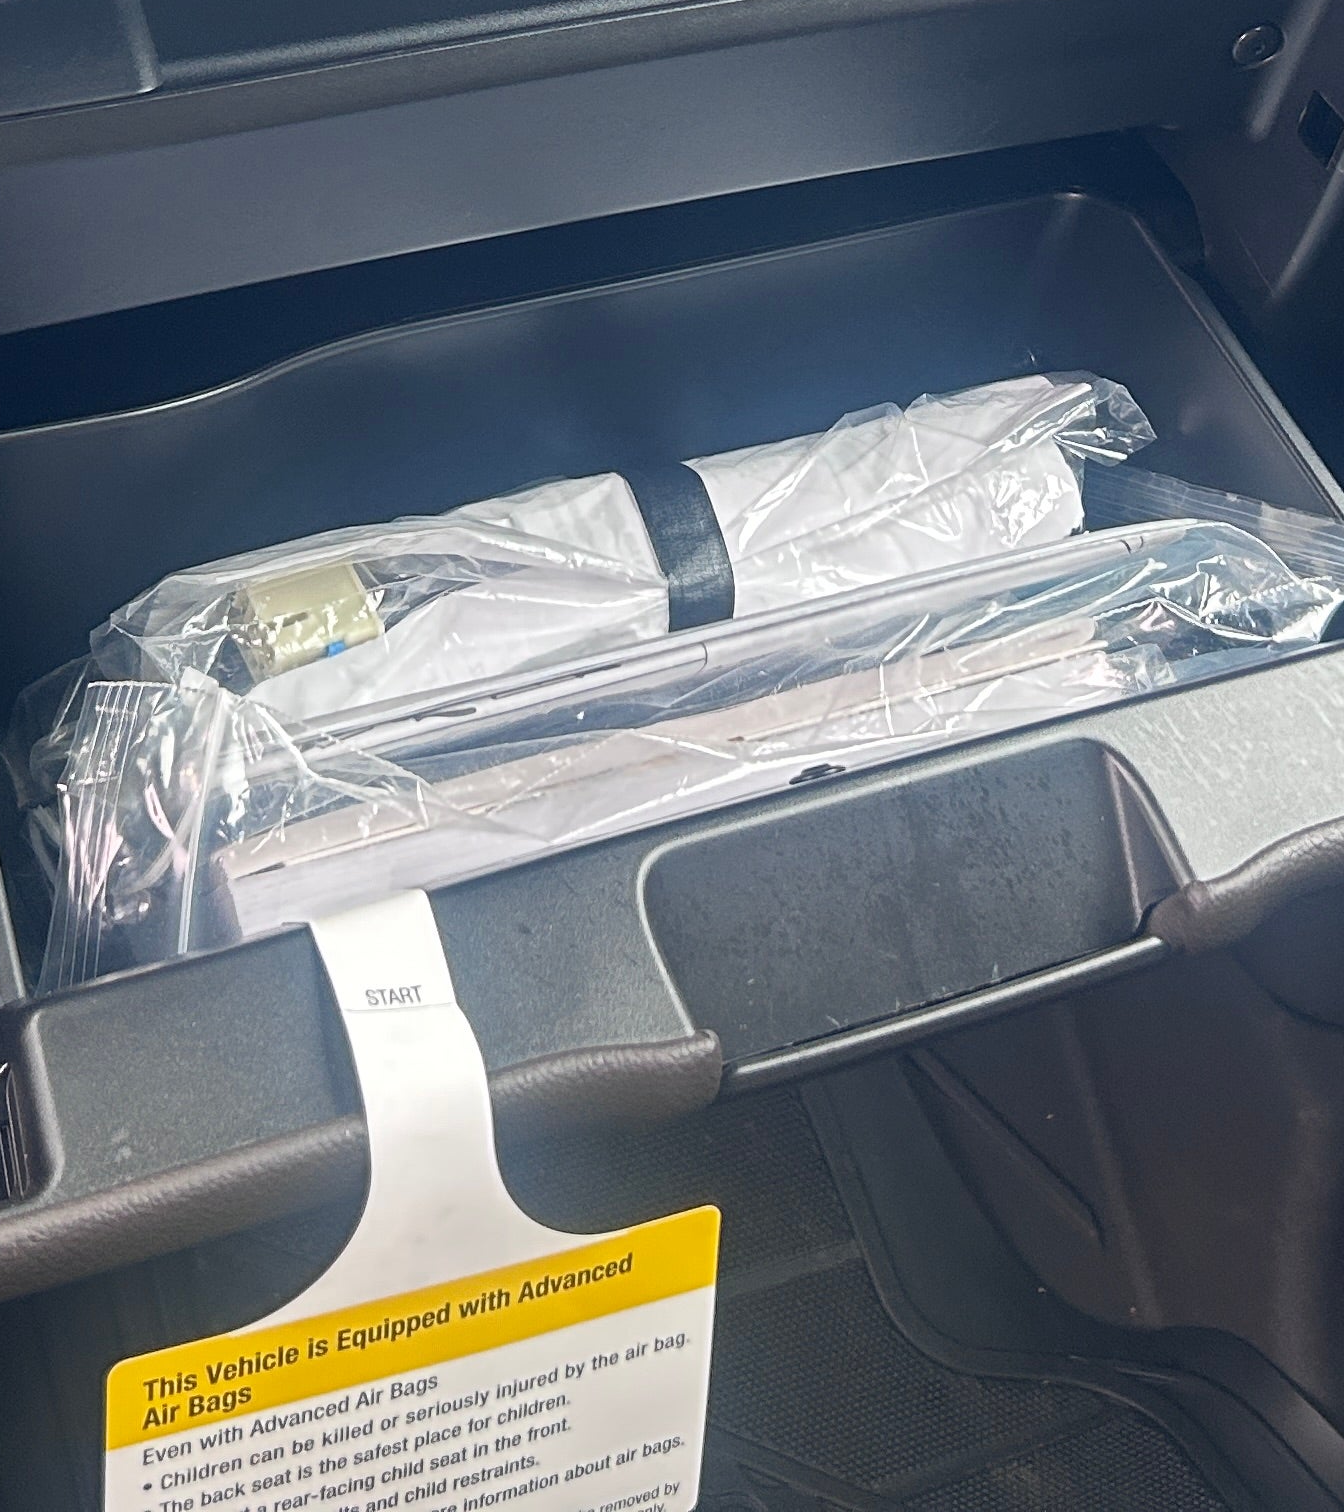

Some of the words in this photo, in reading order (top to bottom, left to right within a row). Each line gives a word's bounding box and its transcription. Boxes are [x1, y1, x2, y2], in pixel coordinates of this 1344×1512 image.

[365, 985, 421, 1006] START
[143, 1372, 197, 1401] This
[206, 1346, 299, 1385] Vehicle
[308, 1338, 328, 1359] is
[337, 1302, 451, 1352] Equipped
[458, 1288, 510, 1319] with
[518, 1252, 633, 1304] Advanced
[142, 1404, 180, 1430] Air
[188, 1387, 252, 1417] Bags
[142, 1441, 192, 1466] Even
[200, 1426, 243, 1450] with
[250, 1395, 350, 1438] Advanced
[355, 1388, 384, 1410] Air
[390, 1376, 438, 1400] Bags
[161, 1458, 242, 1490] Children
[250, 1447, 284, 1466] can
[292, 1439, 314, 1455] be
[322, 1419, 374, 1447] killed
[380, 1416, 399, 1431] or
[406, 1390, 489, 1424] seriously
[496, 1367, 558, 1399] injured
[565, 1362, 585, 1379] by
[592, 1353, 619, 1371] the
[625, 1344, 648, 1361] air
[654, 1333, 690, 1355] bag.
[159, 1498, 194, 1512] The
[200, 1482, 246, 1507] back
[252, 1469, 291, 1493] seat
[298, 1465, 312, 1481] is
[319, 1457, 348, 1474] the
[353, 1437, 408, 1465] safest
[414, 1425, 462, 1452] place
[468, 1416, 492, 1434] for
[497, 1395, 570, 1425] children.
[274, 1476, 375, 1512] rear-facing
[381, 1458, 424, 1484] child
[430, 1447, 467, 1471] seat
[473, 1444, 488, 1459] in
[495, 1434, 522, 1452] the
[528, 1418, 570, 1442] front.
[366, 1492, 399, 1512] and
[405, 1477, 447, 1503] child
[453, 1455, 540, 1491] restraints.
[463, 1474, 559, 1512] information
[564, 1455, 611, 1482] about
[616, 1448, 637, 1466] air
[642, 1436, 684, 1458] bags.
[664, 1482, 680, 1496] by
